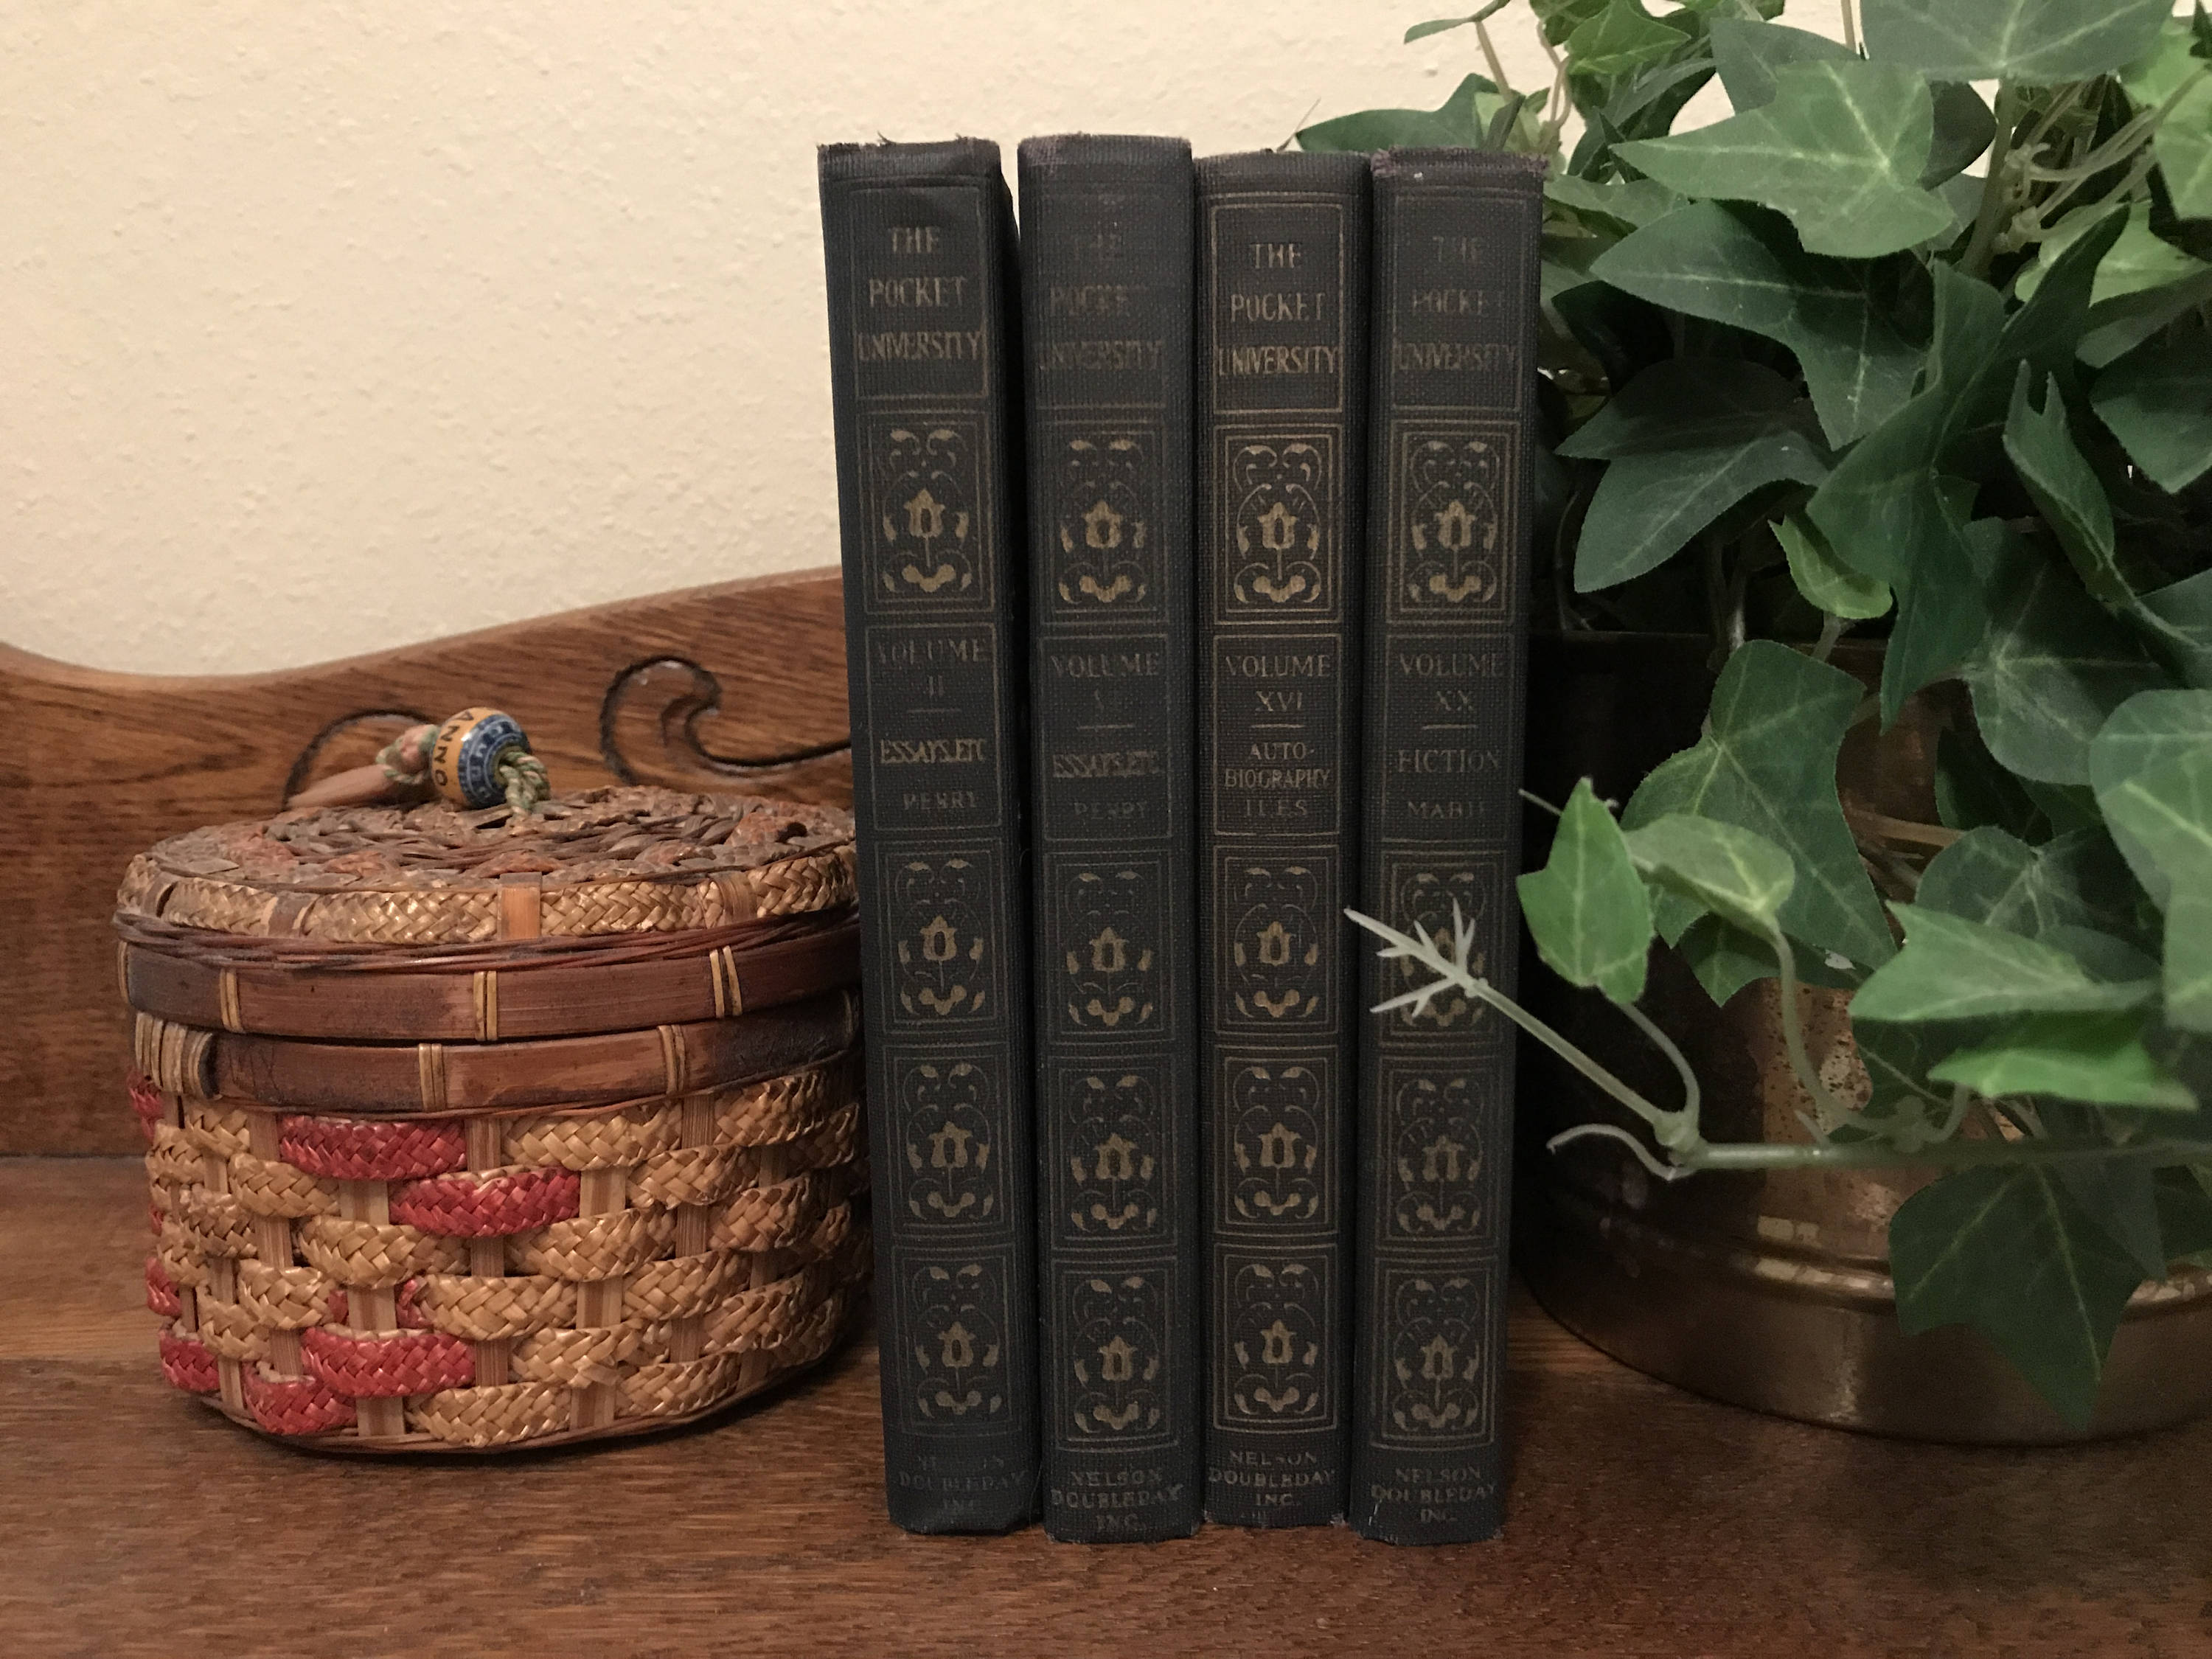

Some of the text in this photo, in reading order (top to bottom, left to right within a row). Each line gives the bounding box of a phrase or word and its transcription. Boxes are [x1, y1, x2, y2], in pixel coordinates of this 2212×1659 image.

[888, 226, 940, 254] THE
[1250, 243, 1302, 269] THE
[868, 276, 967, 307] POCKET
[1231, 293, 1326, 322] POCKET
[857, 331, 982, 361] UNIVERSITY
[1218, 346, 1338, 377] UNIVERSITY
[1050, 653, 1160, 678] VOLUME
[1225, 655, 1331, 678] VOLUME
[1399, 653, 1503, 678] VOLUME
[1256, 690, 1303, 712] XVI
[880, 739, 953, 764] ESSAYS
[1398, 749, 1500, 773] FICTION
[1225, 768, 1331, 789] BIOGRAPHY
[1246, 799, 1308, 816] ILES
[1208, 1467, 1335, 1487] DOUBLEDAY
[1051, 1484, 1183, 1510] DOUBLEDAY
